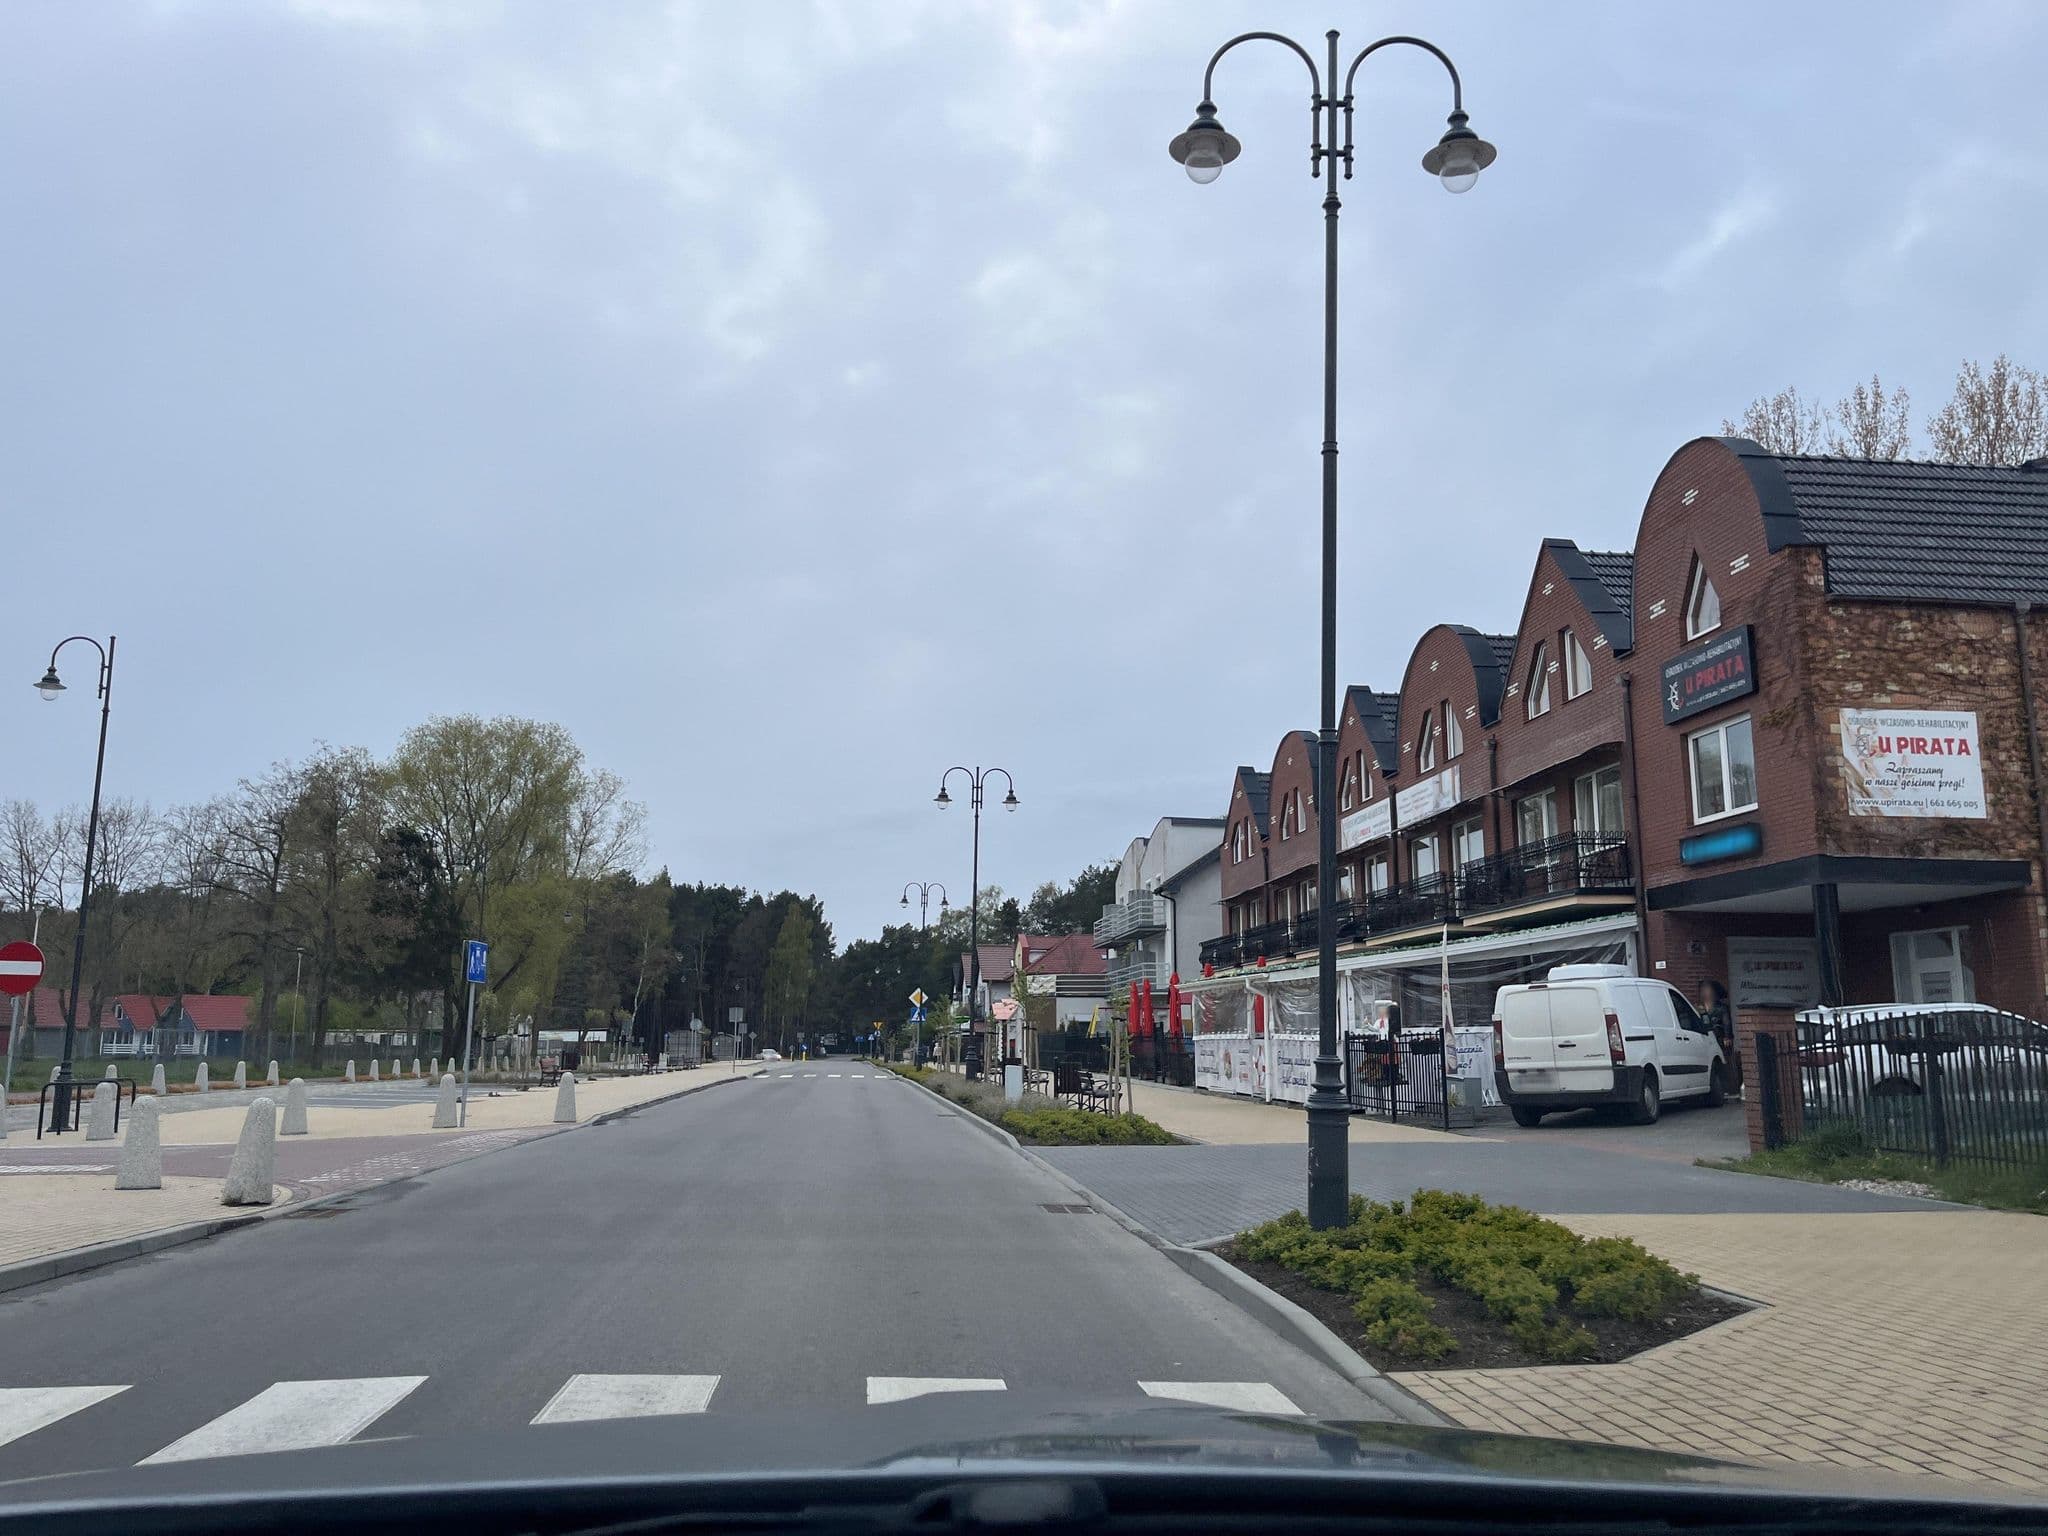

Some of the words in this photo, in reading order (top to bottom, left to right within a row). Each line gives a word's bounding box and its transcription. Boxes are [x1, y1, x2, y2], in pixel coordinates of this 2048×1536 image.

[1685, 676, 1694, 695] U
[1696, 655, 1745, 691] PIRATA
[1880, 718, 1969, 730] WCZASOWO-REHABILITACYJNY
[1878, 735, 1892, 754] U
[1896, 736, 1972, 756] PIRATA
[1884, 761, 1944, 778] Zapraszamy
[1875, 778, 1898, 786] nasze
[1855, 798, 1924, 807] www.upirata.eu
[1946, 800, 1961, 809] 665
